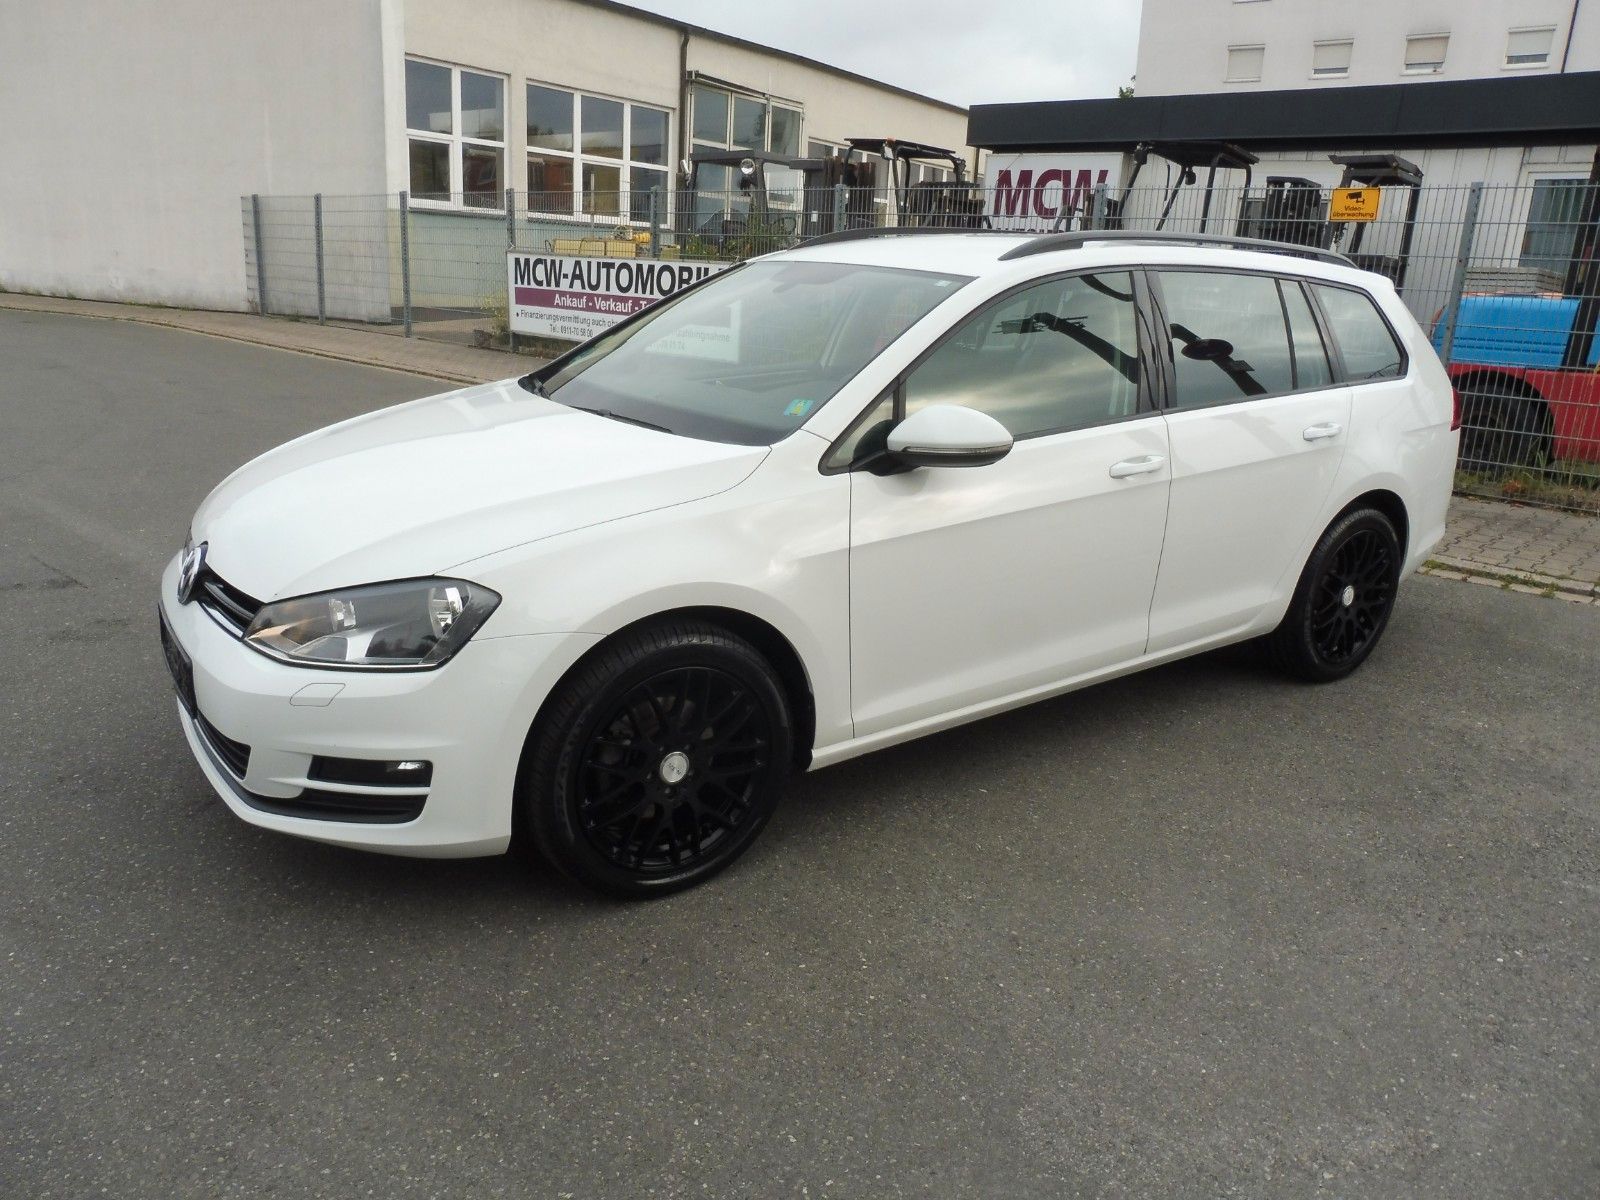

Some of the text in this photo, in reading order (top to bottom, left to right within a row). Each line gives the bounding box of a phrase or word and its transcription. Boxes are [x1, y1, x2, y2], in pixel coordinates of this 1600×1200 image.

[994, 169, 1108, 219] MCW
[554, 294, 587, 308] Ankauf
[594, 297, 633, 312] Verkauf
[592, 317, 606, 327] auch
